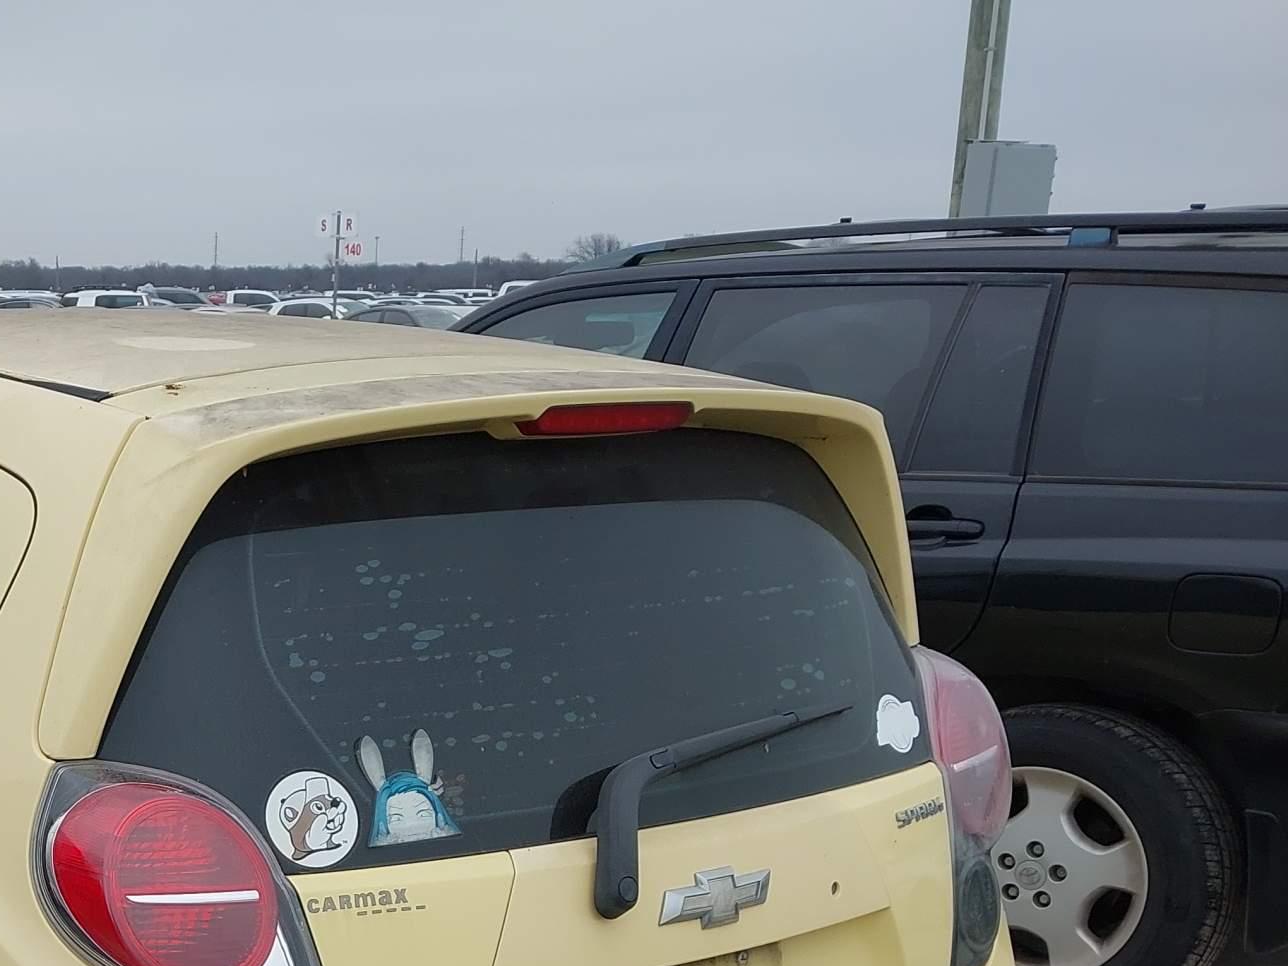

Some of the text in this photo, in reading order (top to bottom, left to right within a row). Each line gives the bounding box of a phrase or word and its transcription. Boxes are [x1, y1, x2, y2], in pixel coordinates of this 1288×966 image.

[321, 219, 327, 232] S
[346, 218, 353, 231] R
[345, 243, 362, 256] 140
